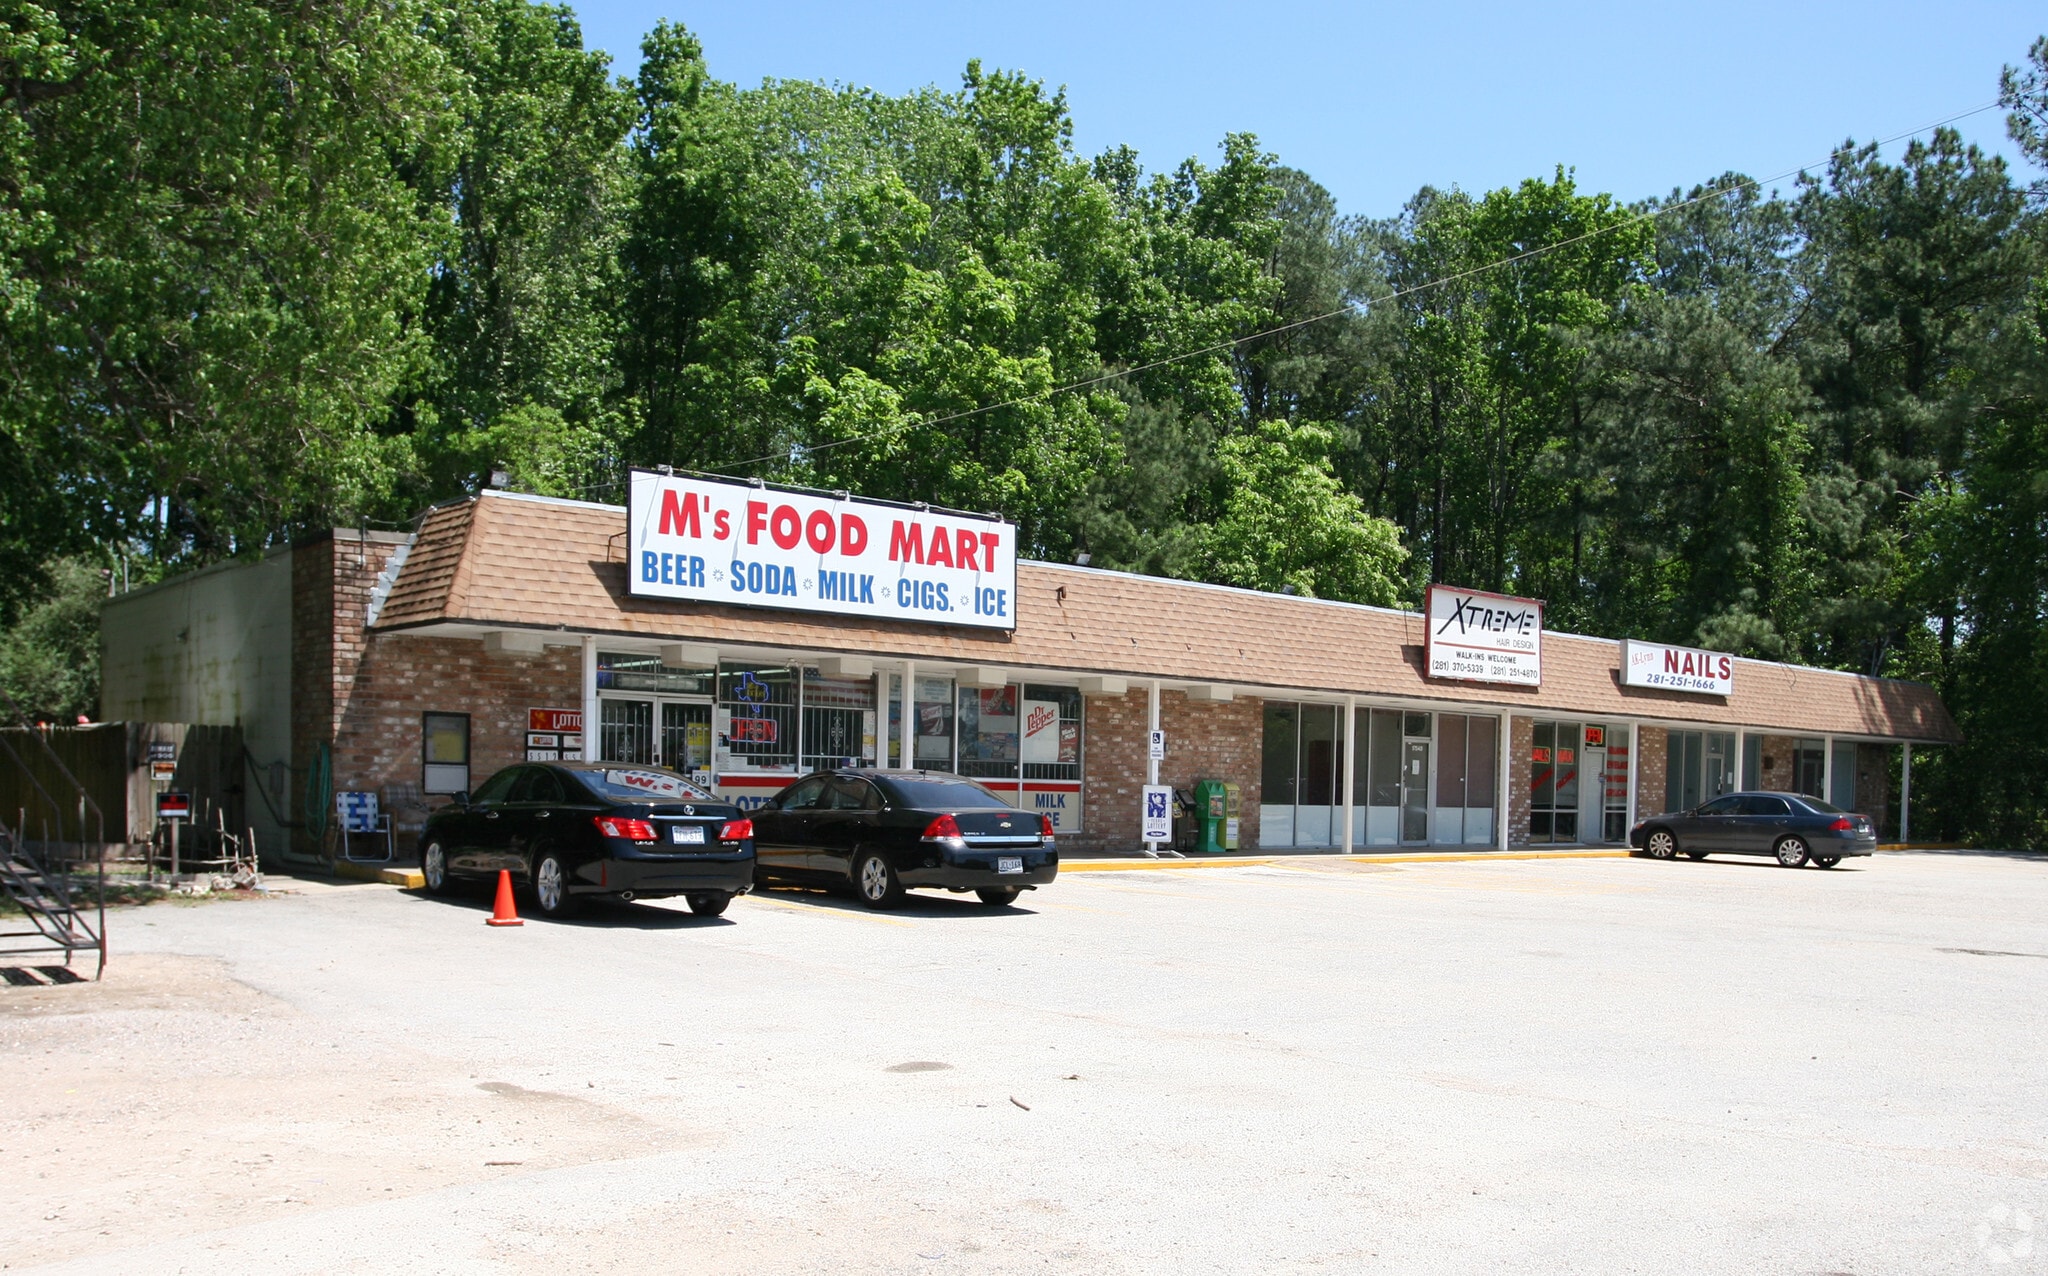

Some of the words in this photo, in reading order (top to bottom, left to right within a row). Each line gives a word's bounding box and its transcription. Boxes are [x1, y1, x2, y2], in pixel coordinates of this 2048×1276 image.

[658, 489, 730, 541] M's
[746, 500, 868, 556] FOOD
[888, 520, 1000, 573] MART
[641, 550, 705, 588] BEER
[730, 560, 797, 597] SODA
[818, 569, 874, 604] MILK
[897, 578, 954, 612] CIGS.
[975, 587, 1007, 617] ICE
[1436, 596, 1534, 635] XTREME
[1496, 638, 1511, 647] HAIR
[1513, 640, 1534, 650] DESIGN
[1455, 651, 1485, 661] WALK-INS
[1487, 654, 1517, 664] WELCOME
[1664, 649, 1731, 680] NAILS
[1432, 659, 1449, 671] (281)
[1452, 663, 1484, 674] 370-5339
[1490, 665, 1506, 676] (281)
[1509, 668, 1538, 678] 251-4870
[1646, 673, 1715, 690] 281-251-1666
[1027, 709, 1055, 731] Pepper
[1034, 706, 1045, 718] Dr
[694, 775, 707, 784] 99
[1035, 793, 1066, 809] MILK
